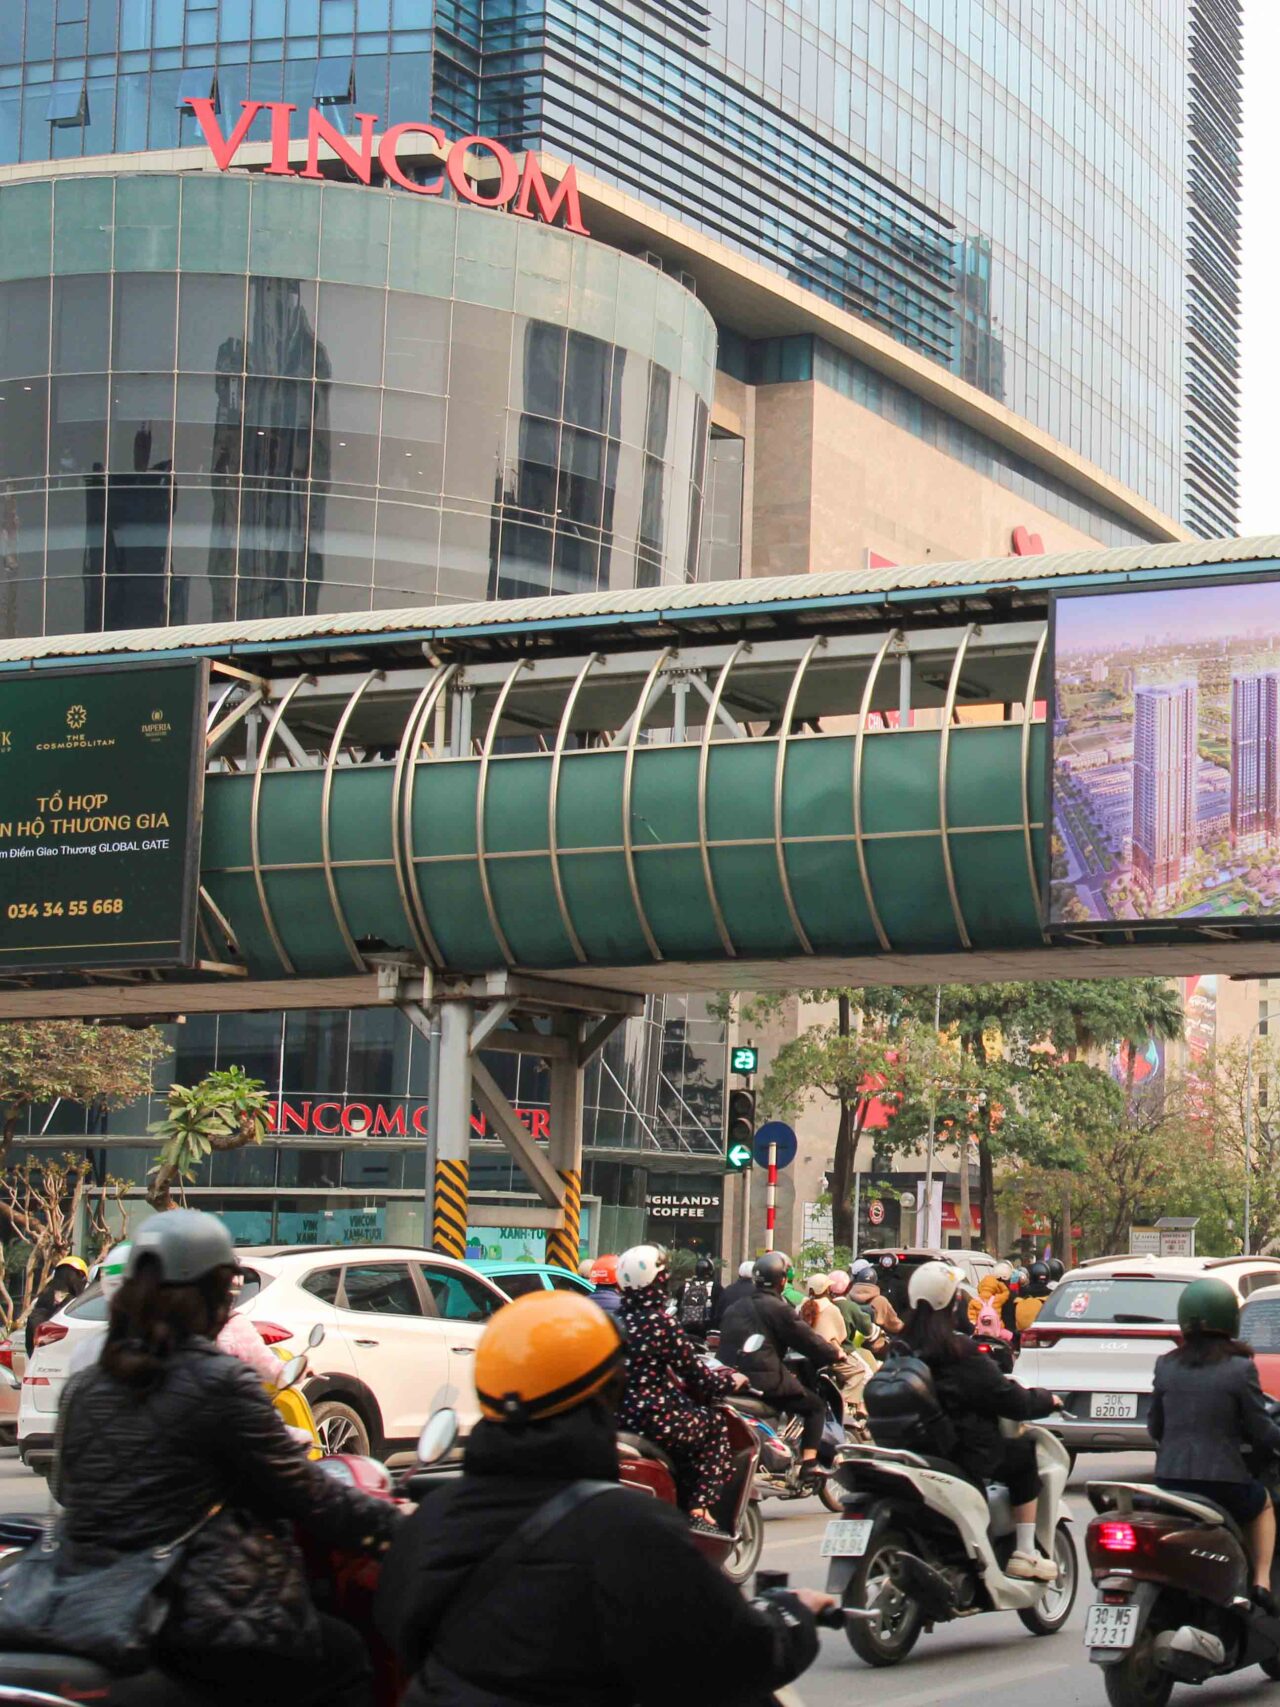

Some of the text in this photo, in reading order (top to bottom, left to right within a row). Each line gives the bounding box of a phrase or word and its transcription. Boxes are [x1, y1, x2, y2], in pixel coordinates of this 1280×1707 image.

[183, 97, 590, 236] VINCOM
[141, 723, 172, 733] IMPERIA
[36, 738, 116, 751] COSMOPOLITAN
[36, 790, 109, 813] TỔ HỢP
[0, 812, 170, 838] N HỘ THƯƠNG GIA
[9, 845, 35, 859] Điểm
[36, 847, 59, 857] Giao
[60, 844, 97, 857] Thương
[98, 842, 140, 853] GLOBAL
[141, 839, 170, 850] GATE
[8, 899, 123, 919] 034 34 55 668
[734, 1051, 755, 1069] 23
[264, 1100, 409, 1136] INCOM
[645, 1194, 719, 1206] GHLANDS
[652, 1206, 705, 1217] COFFEE
[1104, 1394, 1123, 1405] 30K
[1096, 1406, 1131, 1417] 820.07
[1095, 1608, 1131, 1625] 30-M5
